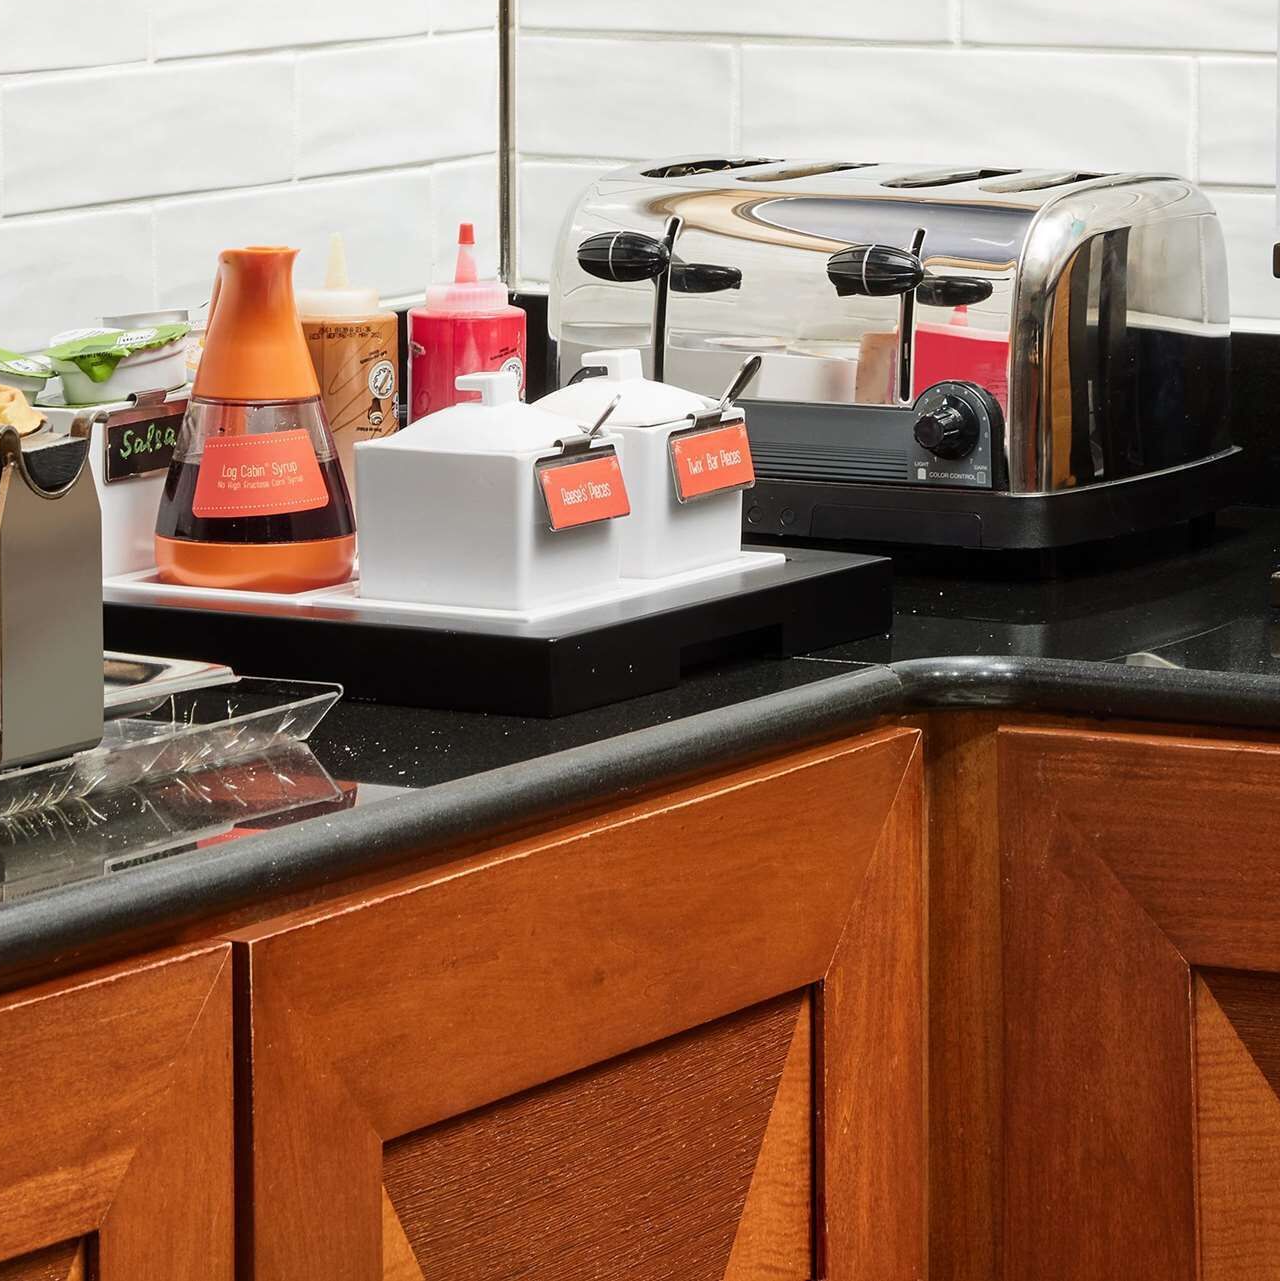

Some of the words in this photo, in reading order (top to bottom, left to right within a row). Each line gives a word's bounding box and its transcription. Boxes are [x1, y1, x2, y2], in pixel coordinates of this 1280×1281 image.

[120, 423, 177, 459] Salsa
[706, 454, 718, 471] Bar
[720, 449, 742, 467] Pieces
[222, 464, 238, 480] Log
[272, 461, 298, 478] Syrup
[928, 471, 949, 479] COLOR
[949, 472, 976, 480] CONTROL
[217, 481, 226, 489] No
[227, 480, 241, 491] High
[243, 480, 270, 489] Fructose
[271, 478, 285, 487] Corn
[587, 481, 612, 501] Pieces
